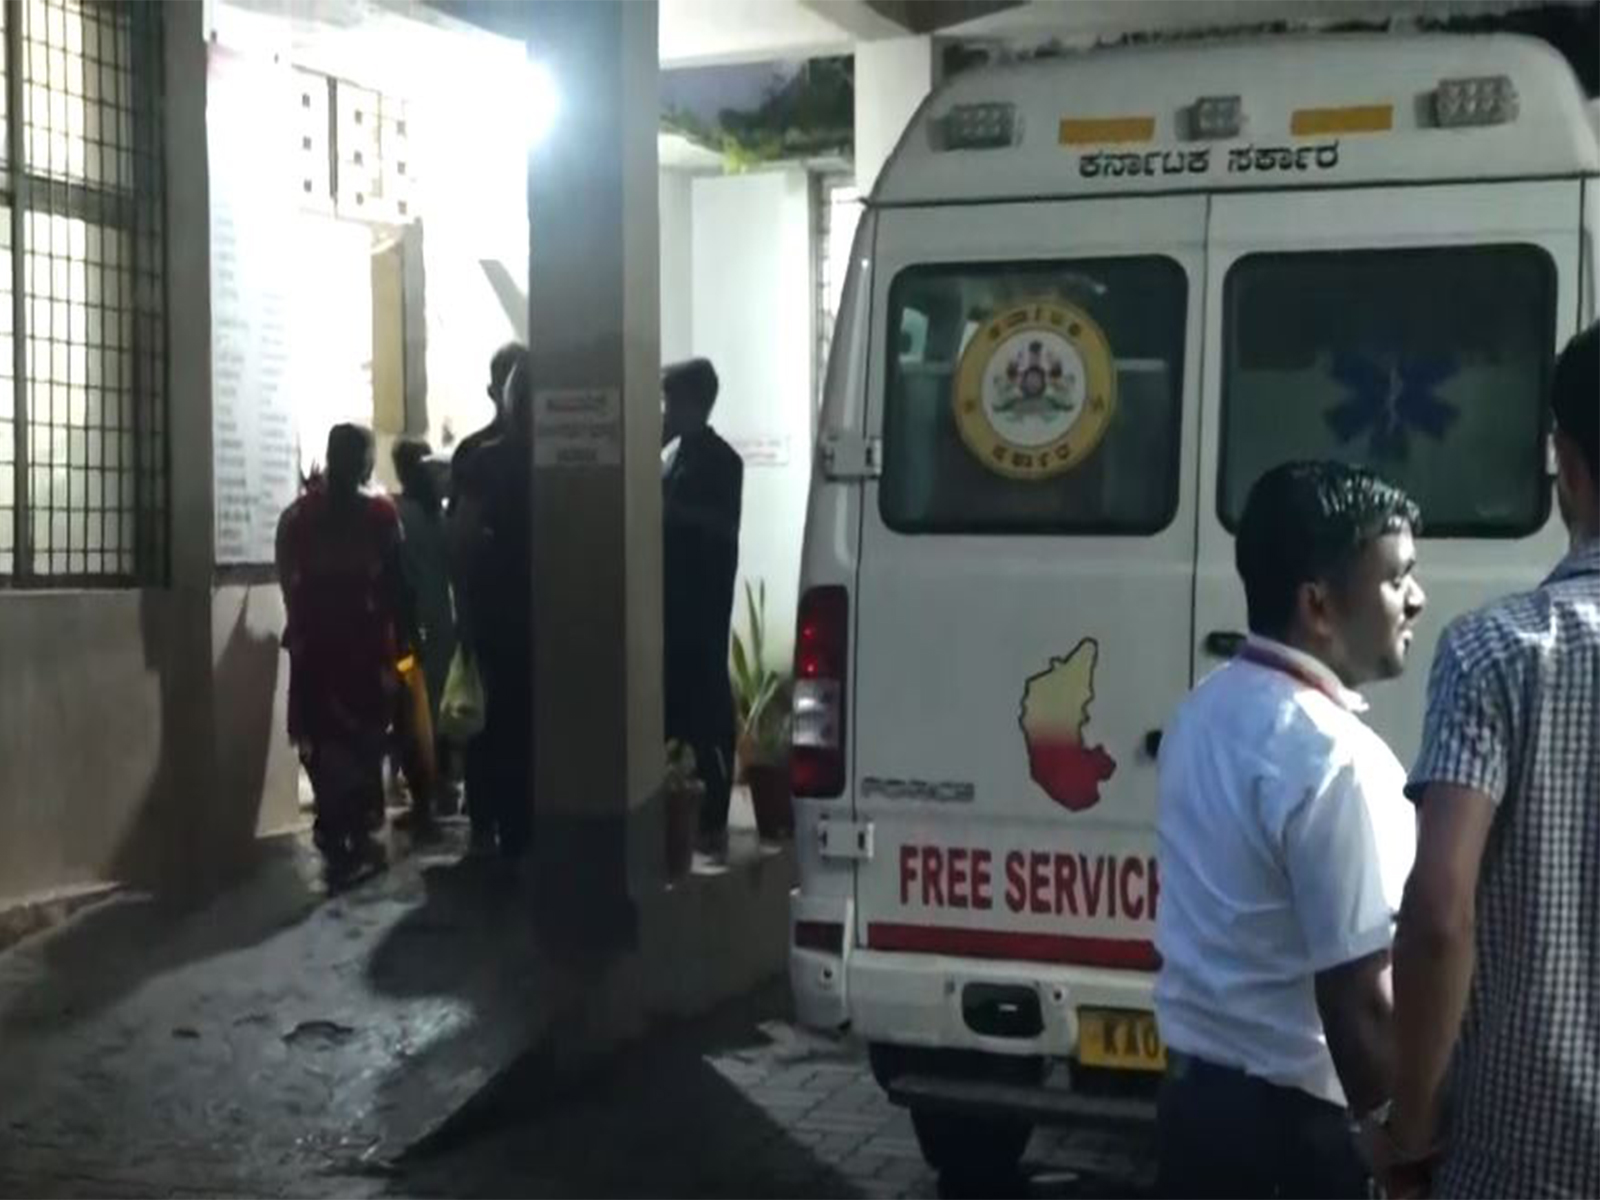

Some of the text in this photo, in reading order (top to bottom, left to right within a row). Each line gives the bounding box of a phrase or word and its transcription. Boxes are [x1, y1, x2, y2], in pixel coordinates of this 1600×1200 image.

[1078, 140, 1339, 179] ಕರ್ನಾಟಕ ಸರ್ಕಾರ
[900, 845, 993, 910] FREE
[1103, 1020, 1168, 1060] KA0
